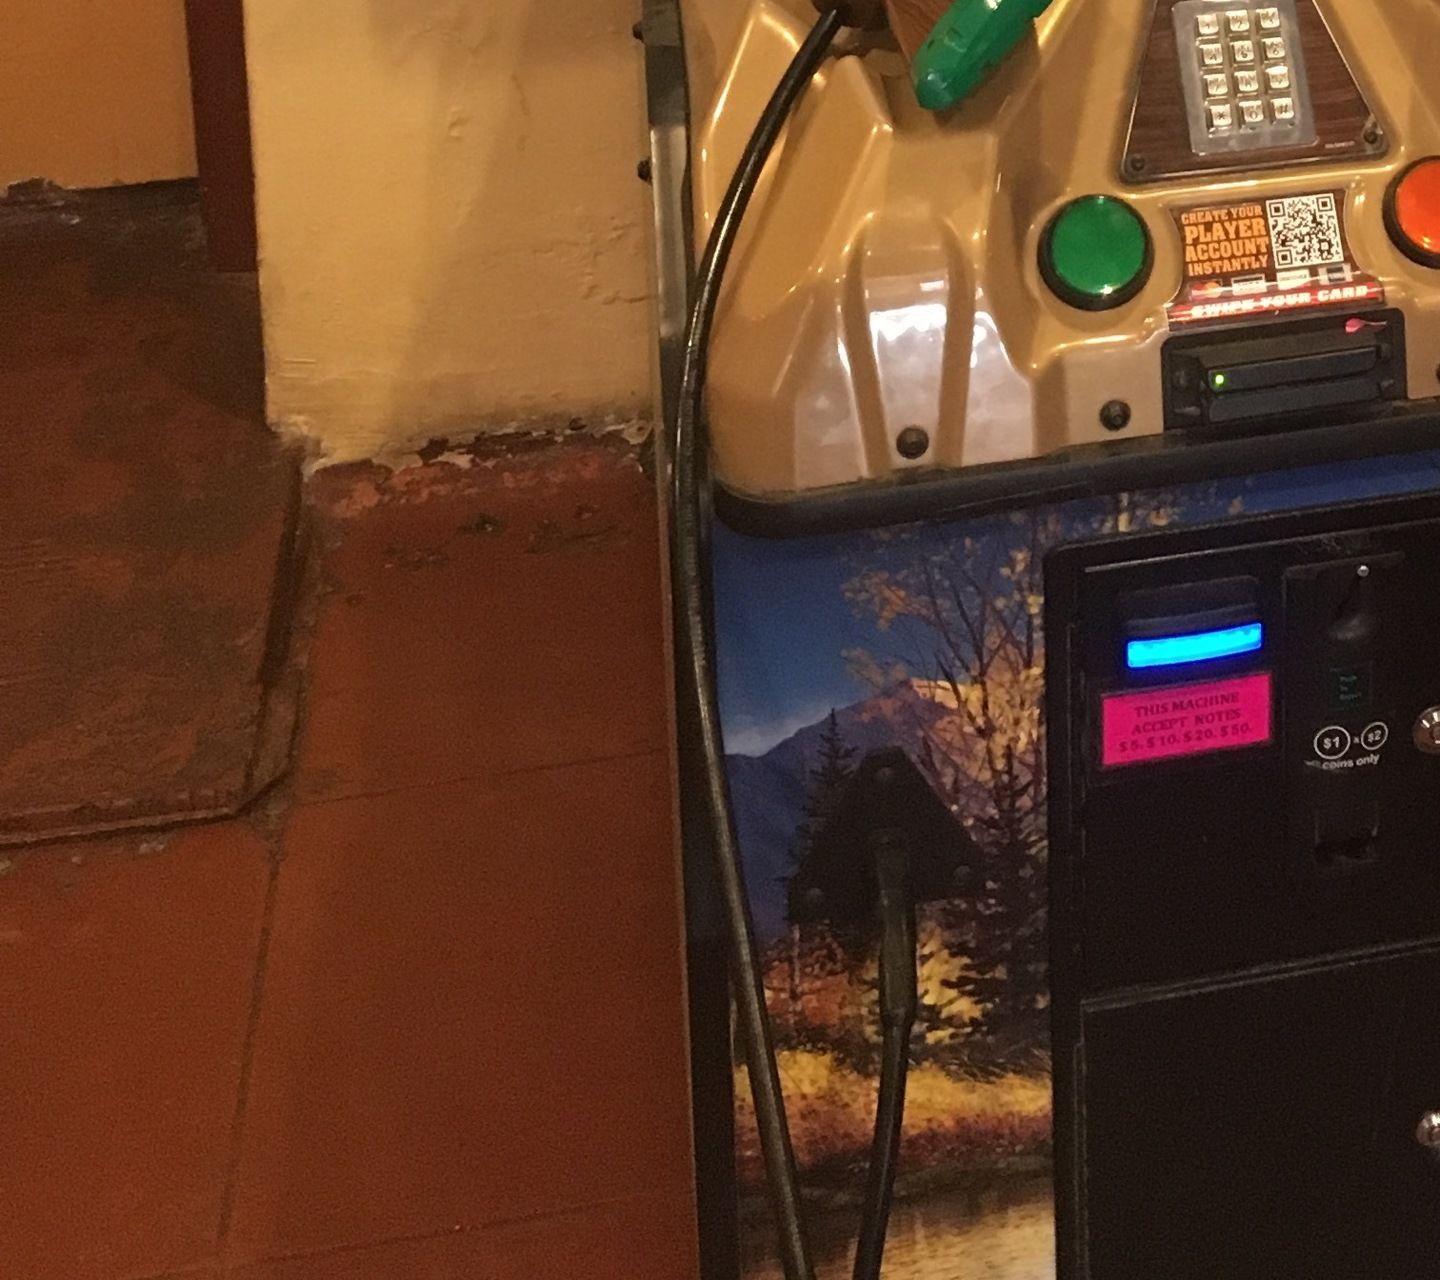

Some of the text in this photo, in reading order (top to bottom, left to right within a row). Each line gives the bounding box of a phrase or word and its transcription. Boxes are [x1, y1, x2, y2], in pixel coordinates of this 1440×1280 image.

[1181, 205, 1263, 225] CREATE YOUR
[1184, 218, 1267, 244] PLAYER
[1185, 238, 1270, 263] ACCOUNT
[1188, 254, 1269, 277] INSTANTLY
[1257, 292, 1311, 309] YOUR
[1317, 285, 1368, 301] CARD
[1134, 691, 1240, 718] THIS MACHINE
[1131, 708, 1242, 736] ACCEPT NOTES
[1322, 736, 1340, 750] $1
[1367, 729, 1382, 743] $2
[1321, 753, 1380, 770] coins only
